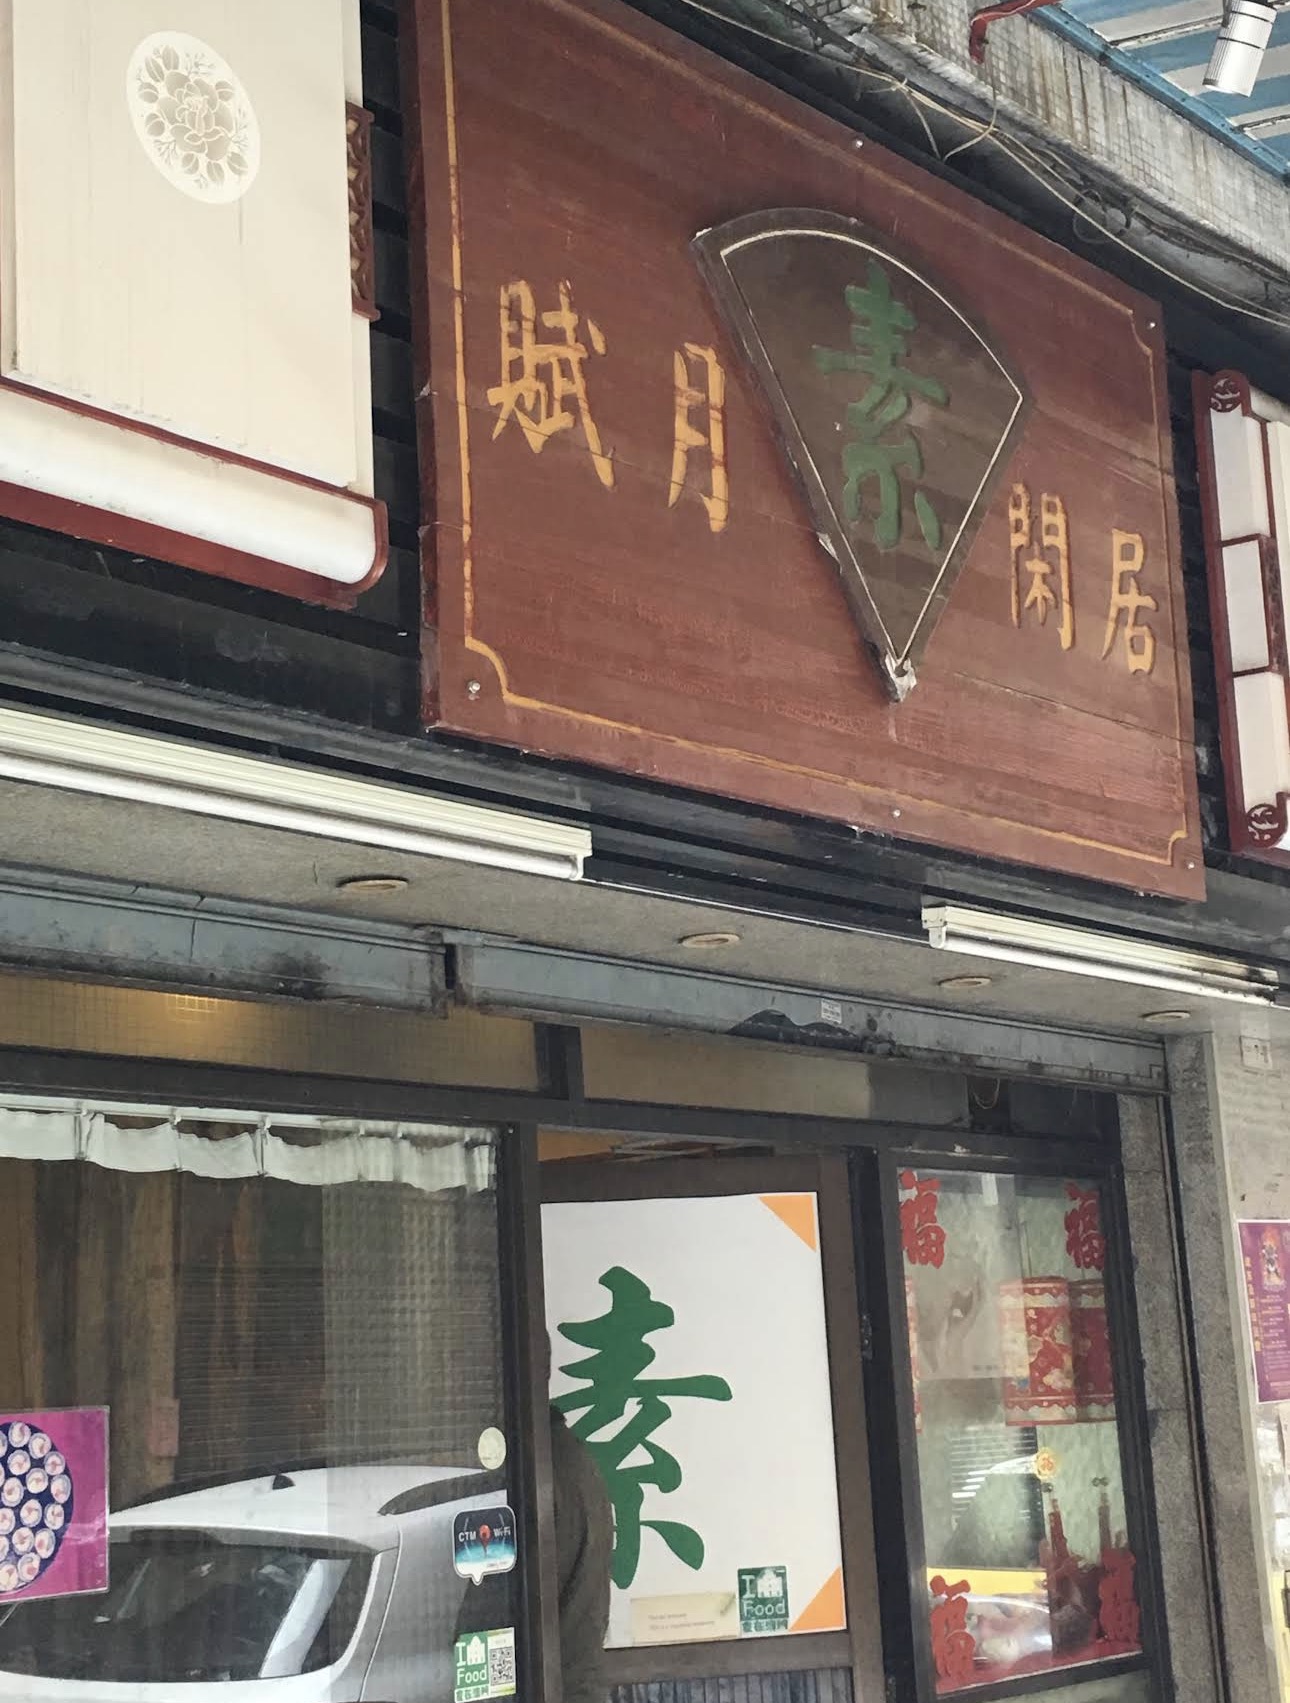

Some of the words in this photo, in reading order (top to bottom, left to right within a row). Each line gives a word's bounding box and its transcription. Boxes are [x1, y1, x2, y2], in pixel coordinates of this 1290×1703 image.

[812, 258, 951, 553] 素
[548, 1265, 733, 1590] 素
[458, 1530, 477, 1542] CTM
[493, 1525, 511, 1538] Wi-Fi
[742, 1598, 786, 1617] Food
[456, 1664, 488, 1686] Food
